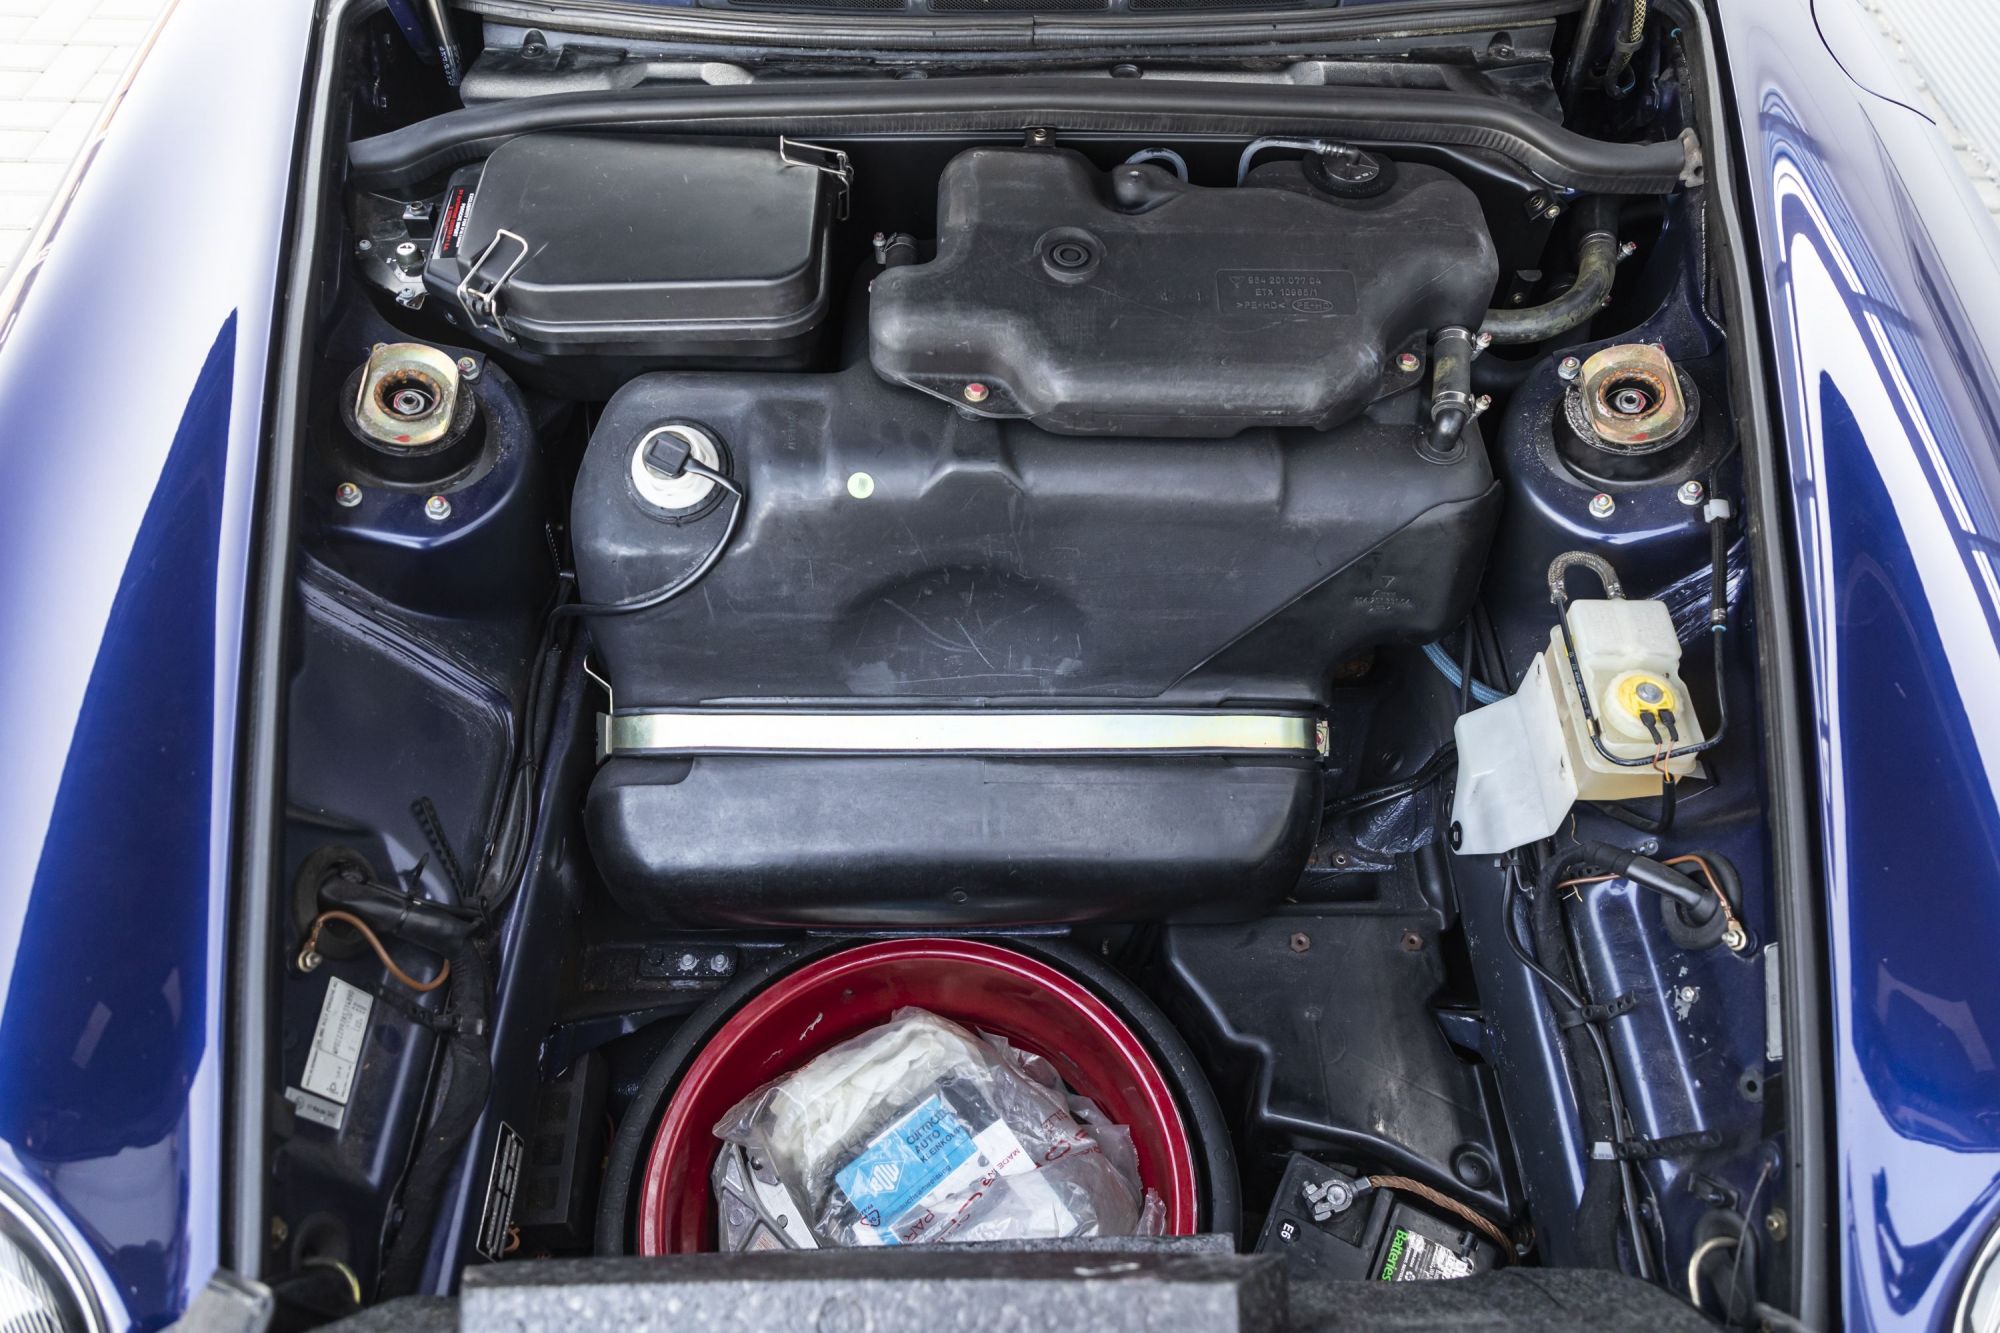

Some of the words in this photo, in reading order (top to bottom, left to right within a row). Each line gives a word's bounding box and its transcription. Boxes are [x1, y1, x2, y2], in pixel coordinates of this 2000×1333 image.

[914, 1129, 941, 1154] AUTO
[1280, 1223, 1294, 1240] E6
[1381, 1229, 1409, 1281] Batteries
